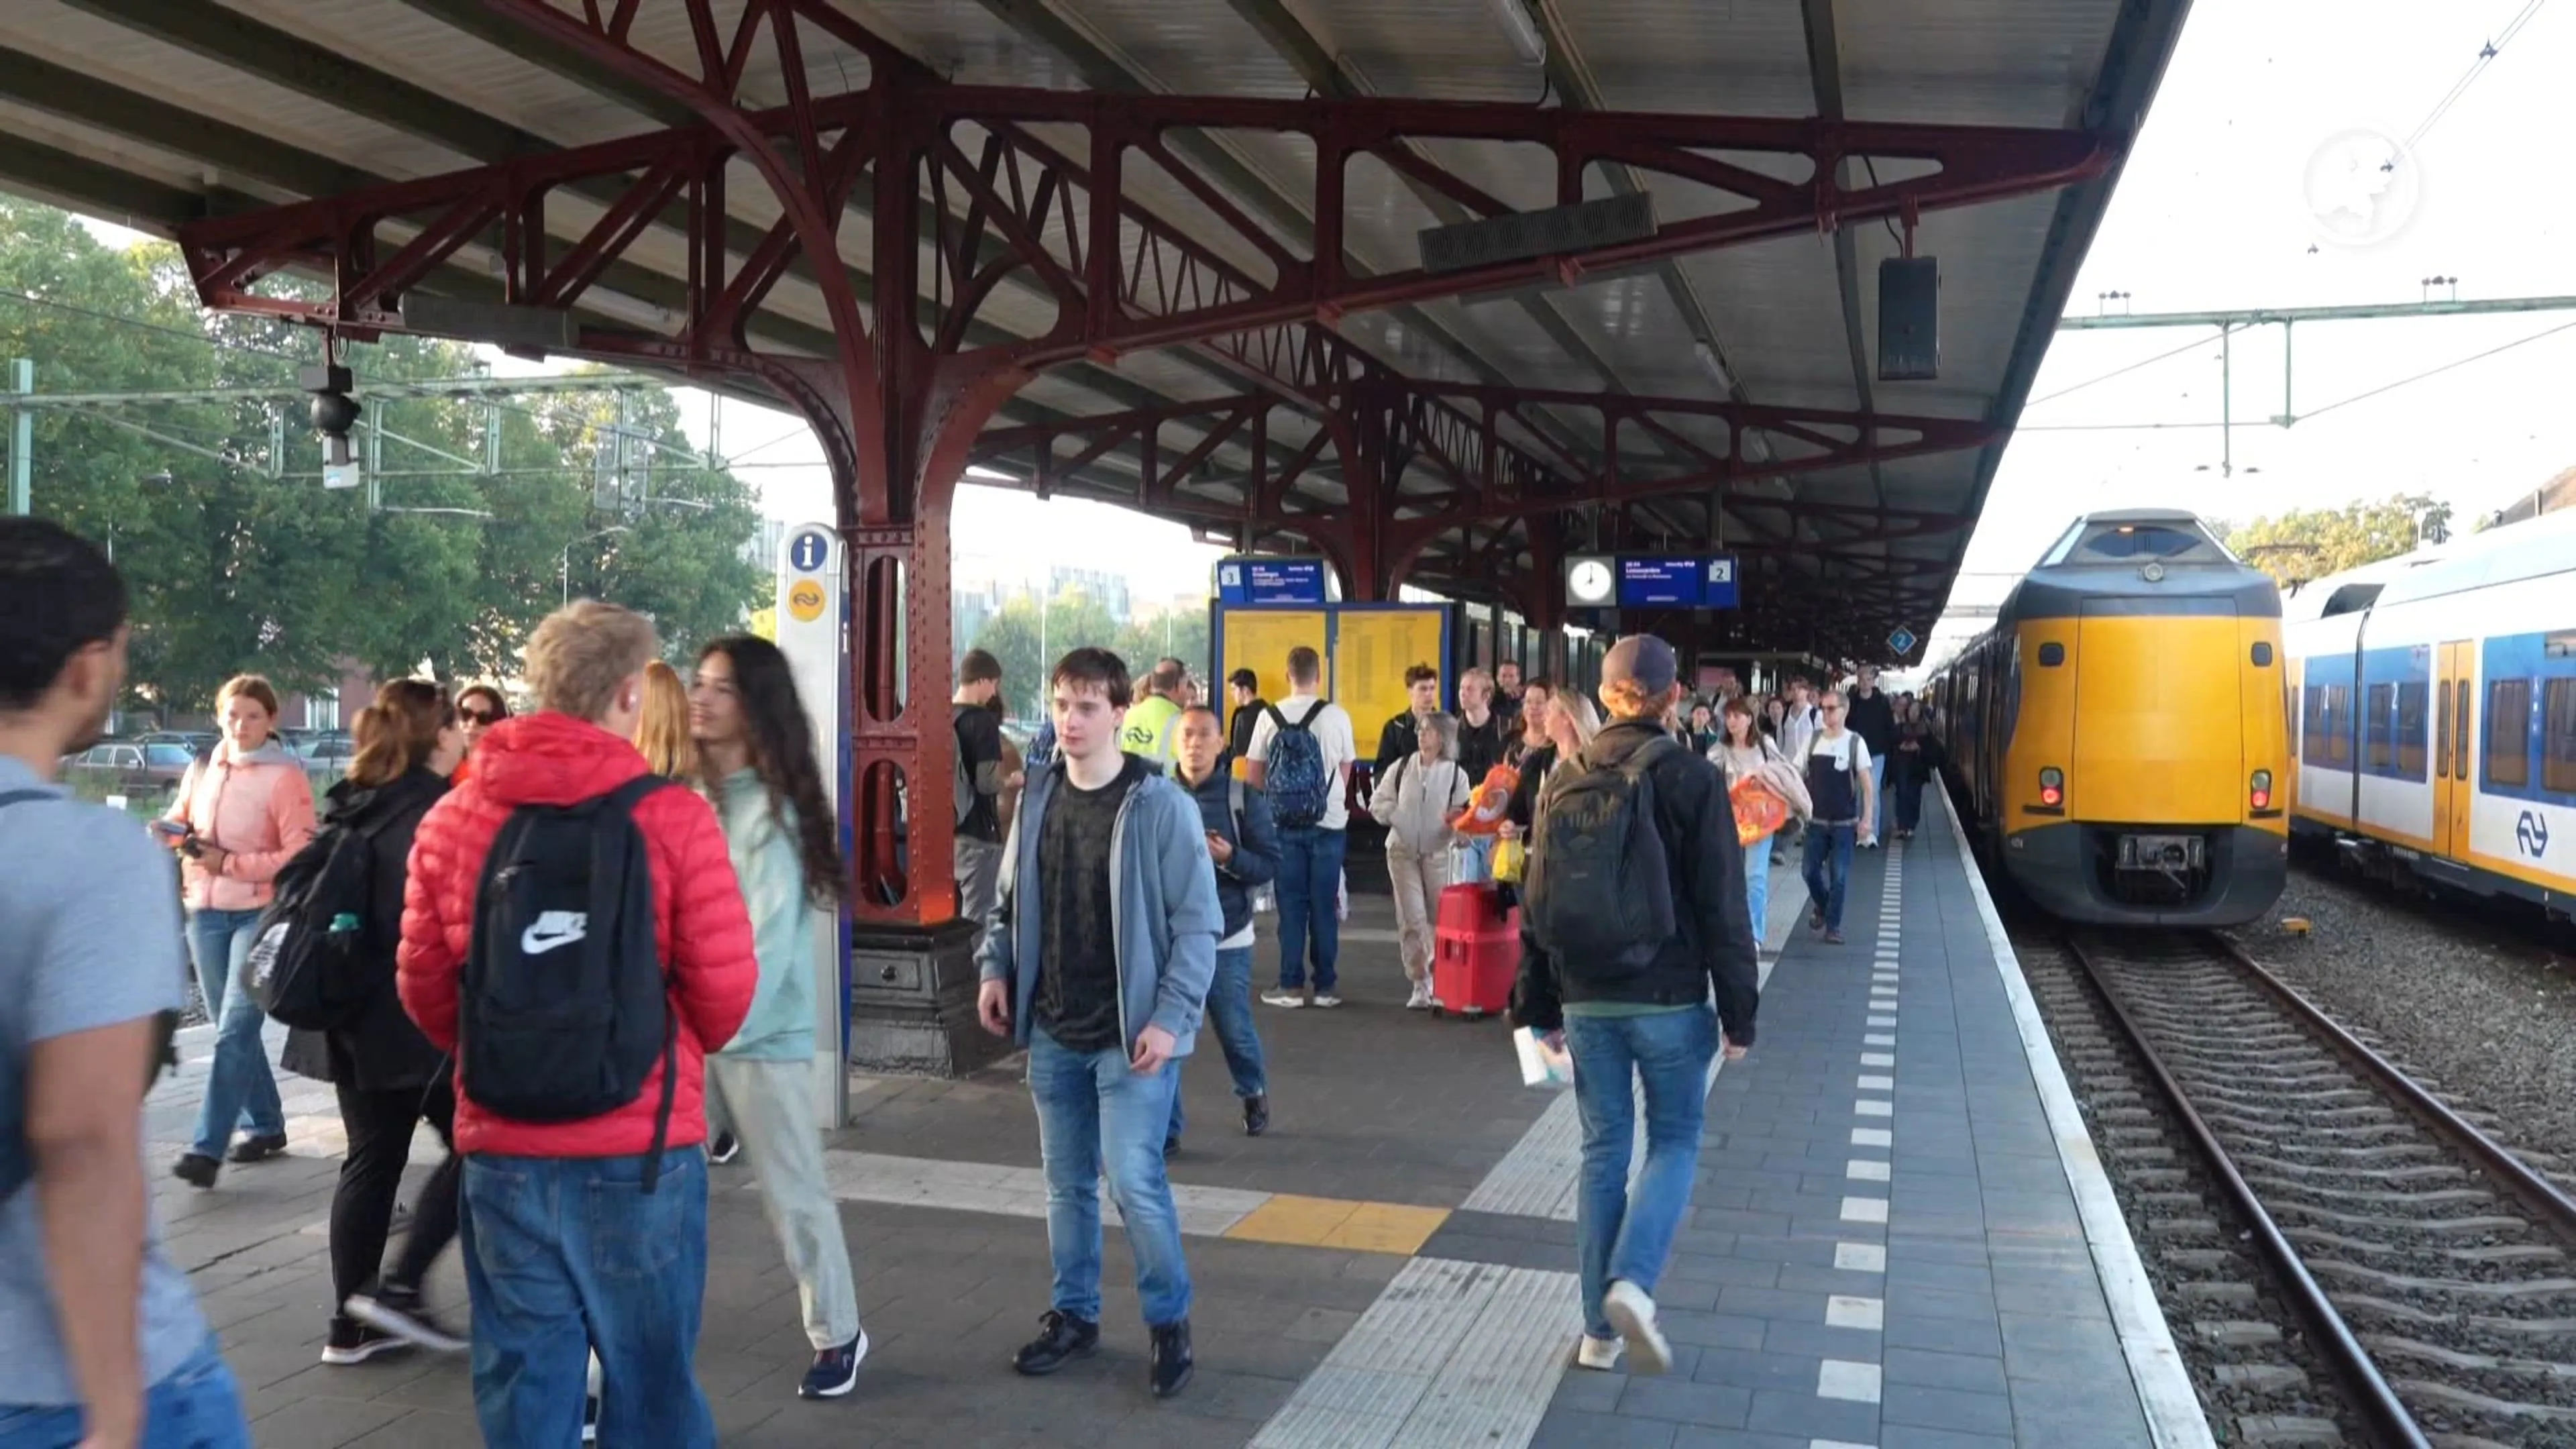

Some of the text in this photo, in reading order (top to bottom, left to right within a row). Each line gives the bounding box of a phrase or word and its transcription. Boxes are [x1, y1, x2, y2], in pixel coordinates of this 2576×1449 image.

[1227, 571, 1234, 584] 3
[1716, 567, 1724, 580] 2
[1898, 633, 1906, 647] 2
[2391, 680, 2398, 710] 2
